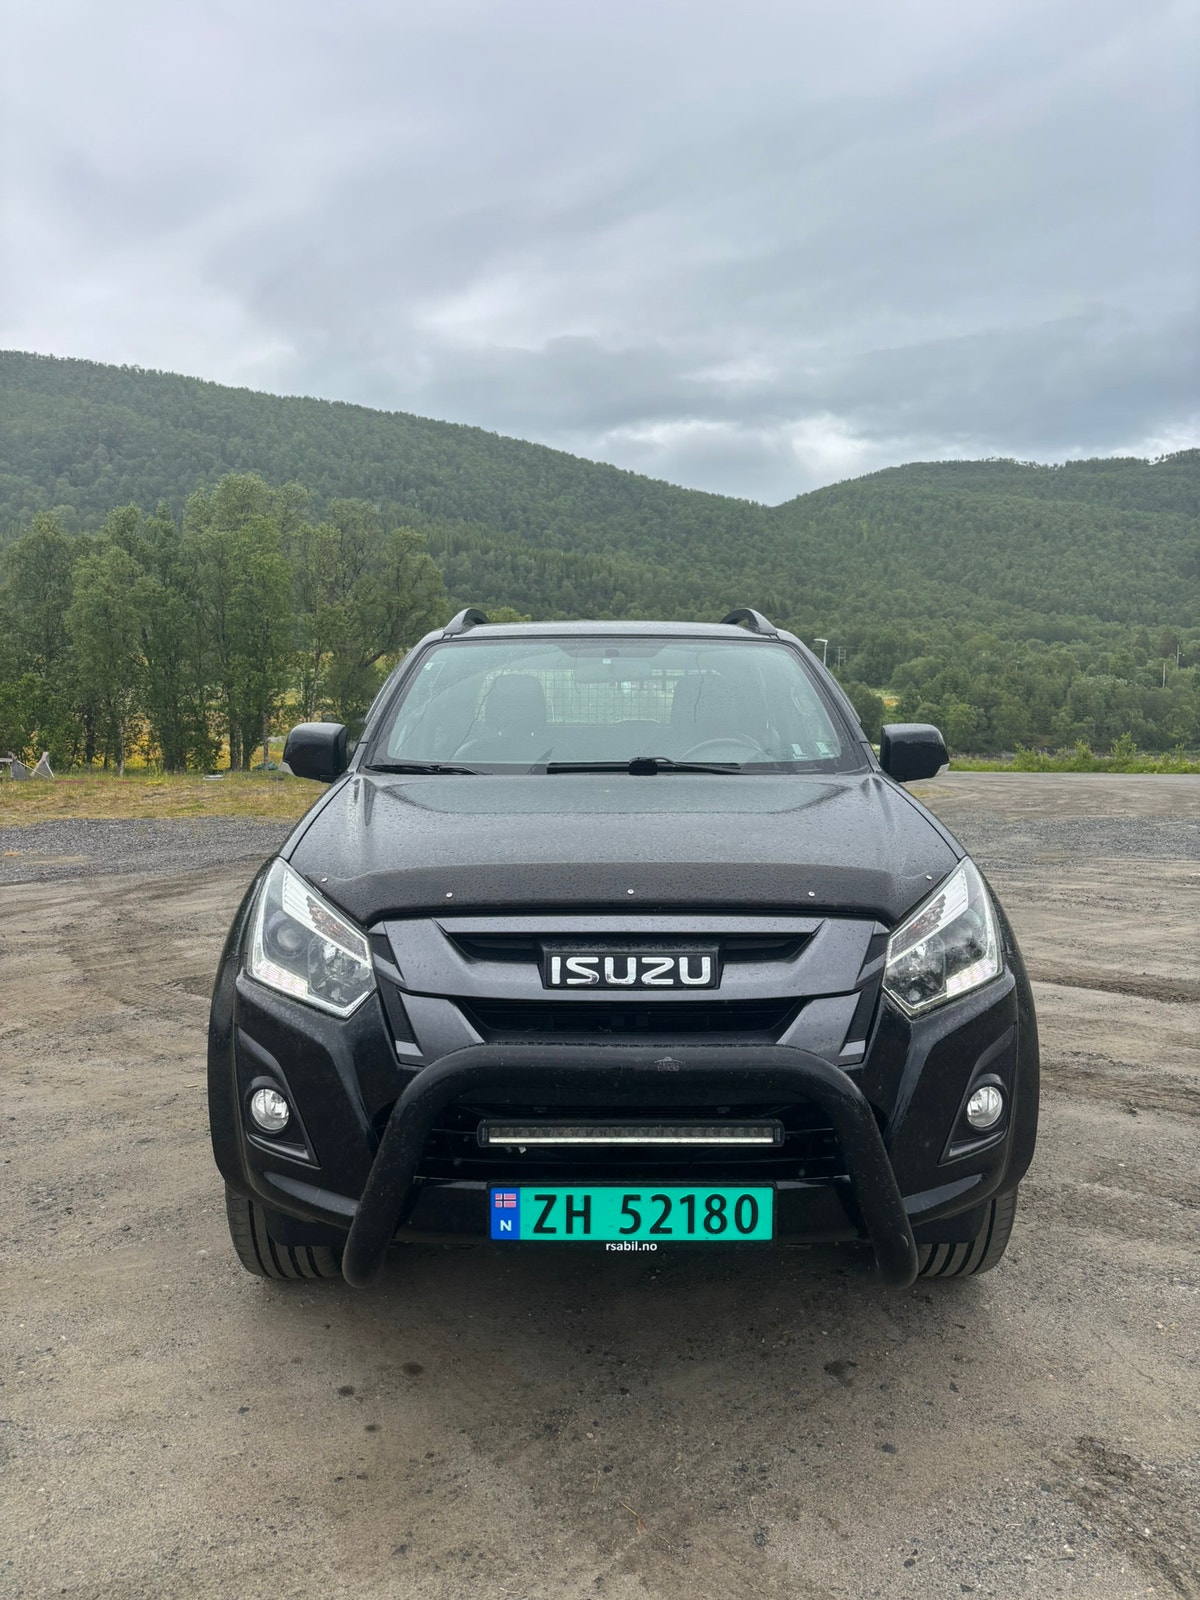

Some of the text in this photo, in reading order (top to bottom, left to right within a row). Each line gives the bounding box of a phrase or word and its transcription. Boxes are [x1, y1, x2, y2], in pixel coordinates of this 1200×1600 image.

[551, 956, 711, 985] ISUZU
[533, 1193, 759, 1235] ZH 52180
[500, 1220, 512, 1231] N
[605, 1240, 658, 1252] rsabil.no
